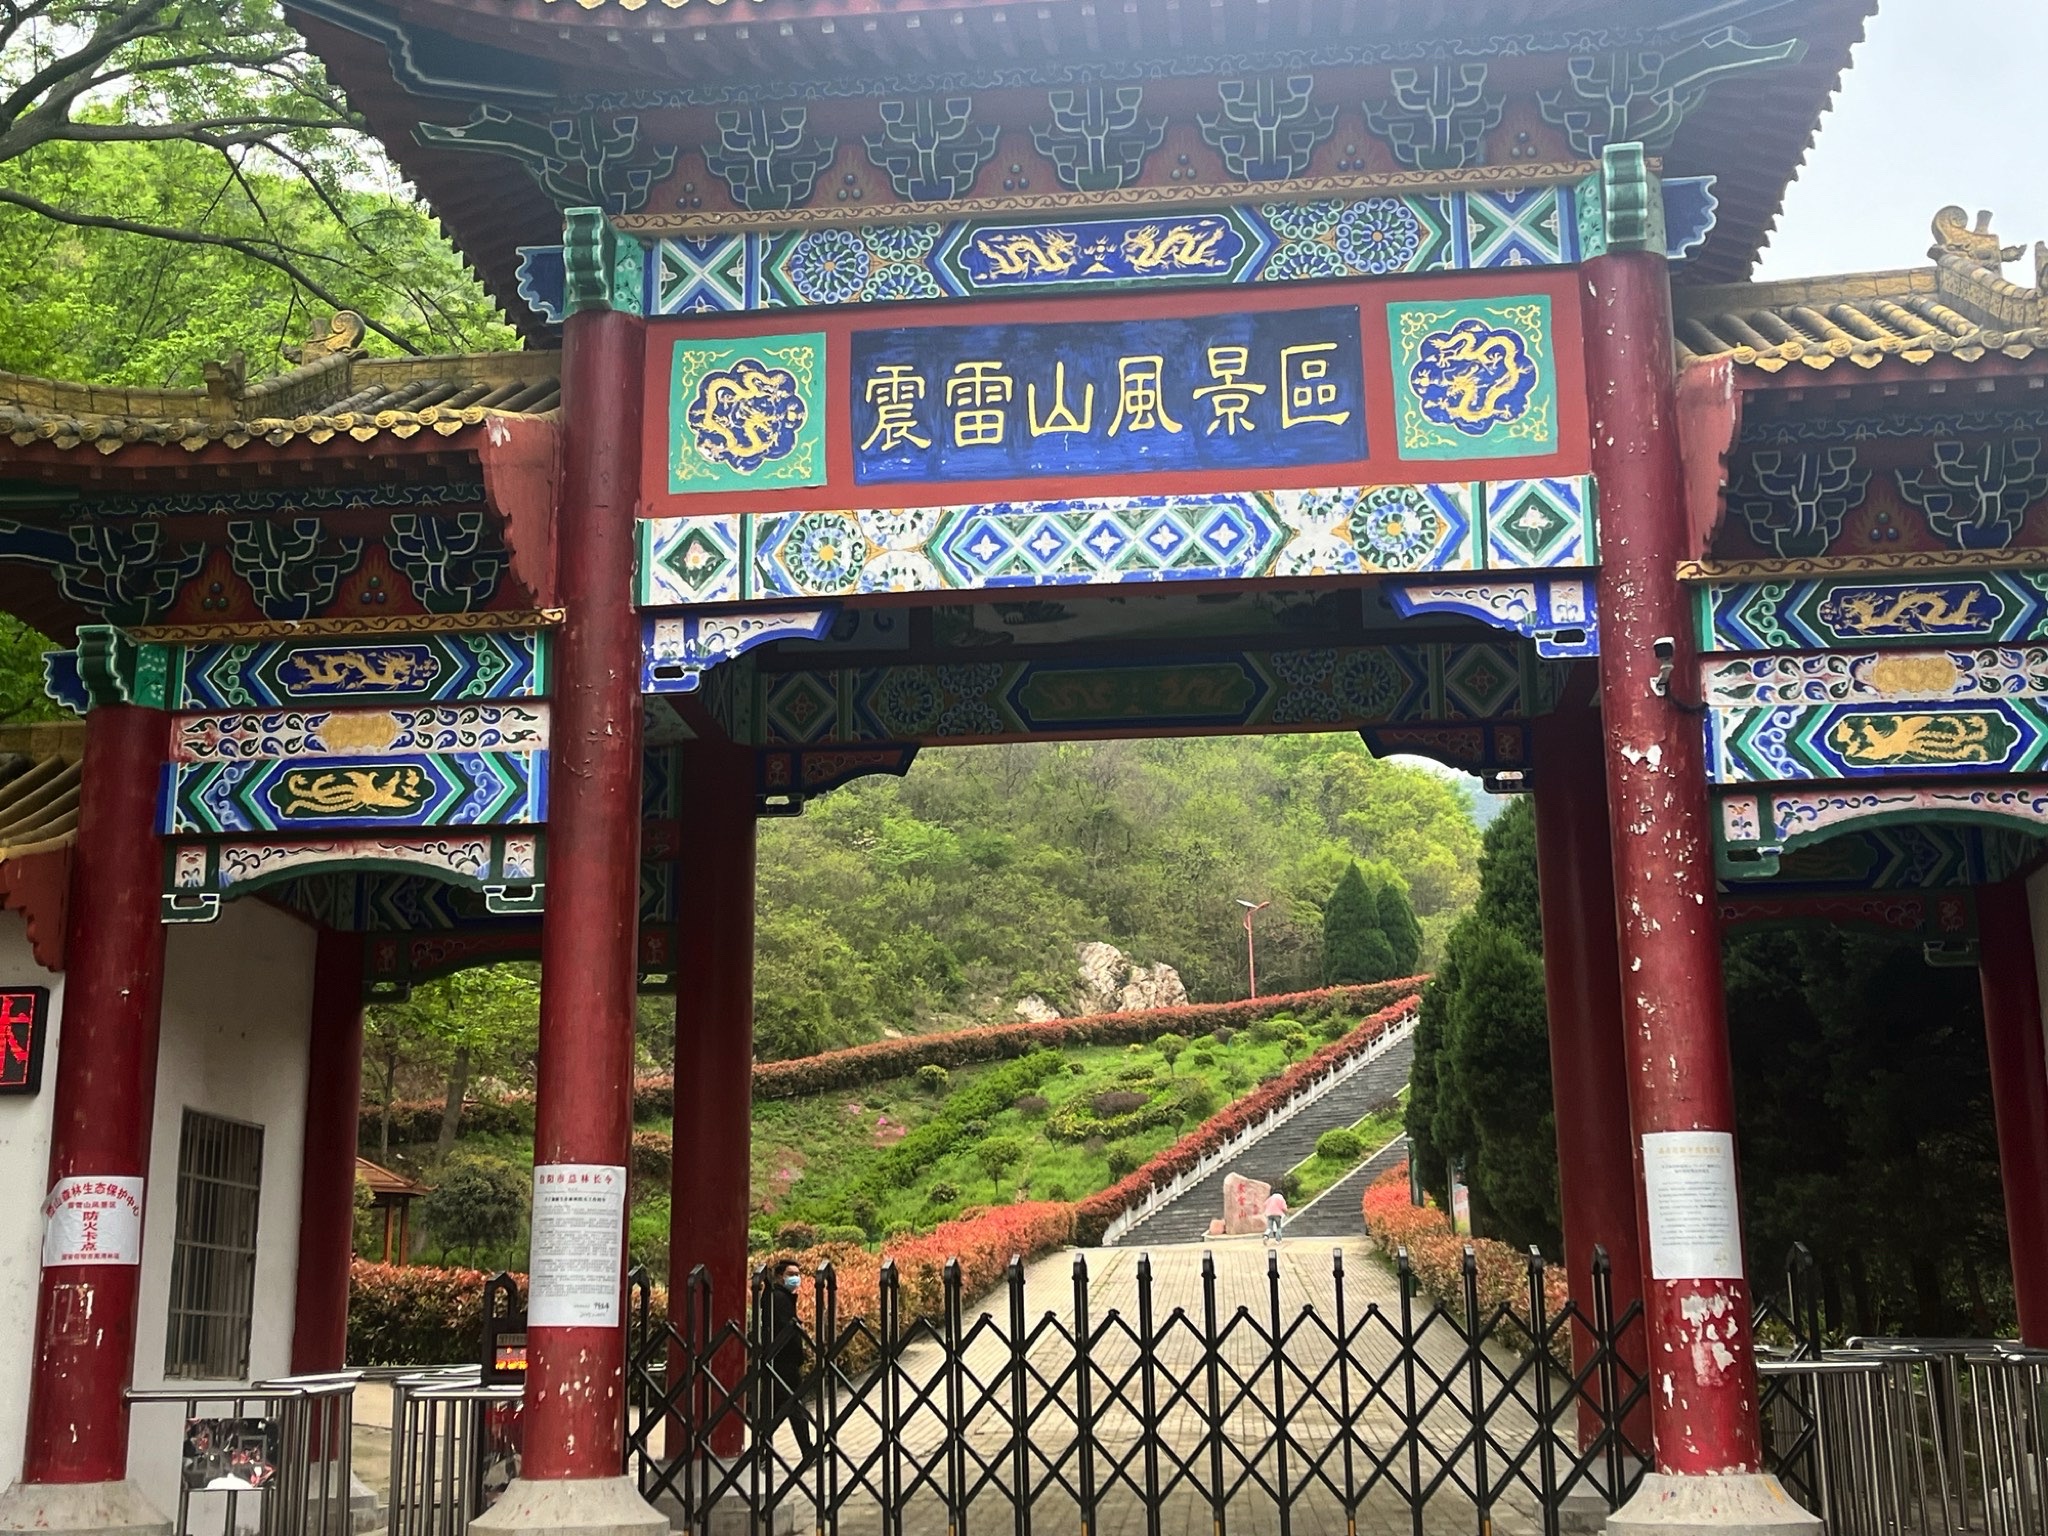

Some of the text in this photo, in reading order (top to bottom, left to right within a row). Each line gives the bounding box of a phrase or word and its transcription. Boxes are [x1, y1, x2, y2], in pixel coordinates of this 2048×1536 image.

[860, 341, 1351, 452] 震雷山風景區
[81, 1211, 98, 1251] 防火卡点
